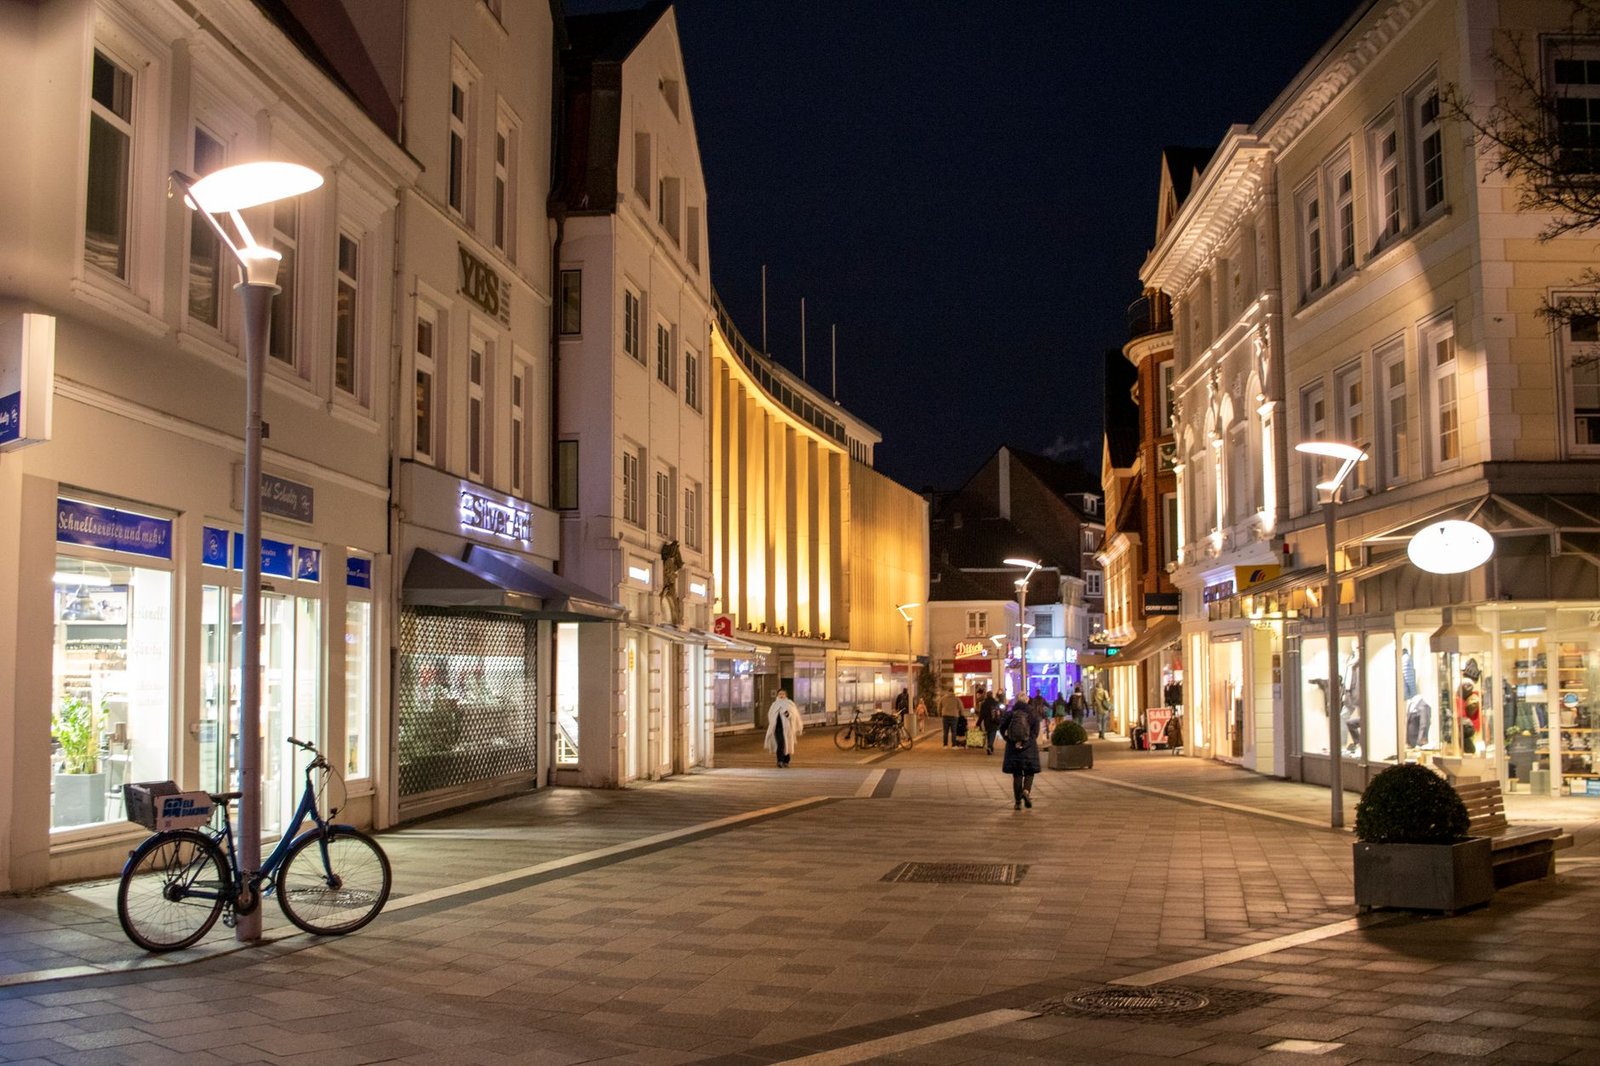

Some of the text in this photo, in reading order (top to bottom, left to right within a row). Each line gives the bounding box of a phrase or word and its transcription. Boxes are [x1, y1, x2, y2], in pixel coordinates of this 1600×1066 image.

[59, 511, 166, 545] Schnellservice und mehr!
[1149, 709, 1171, 720] SALE
